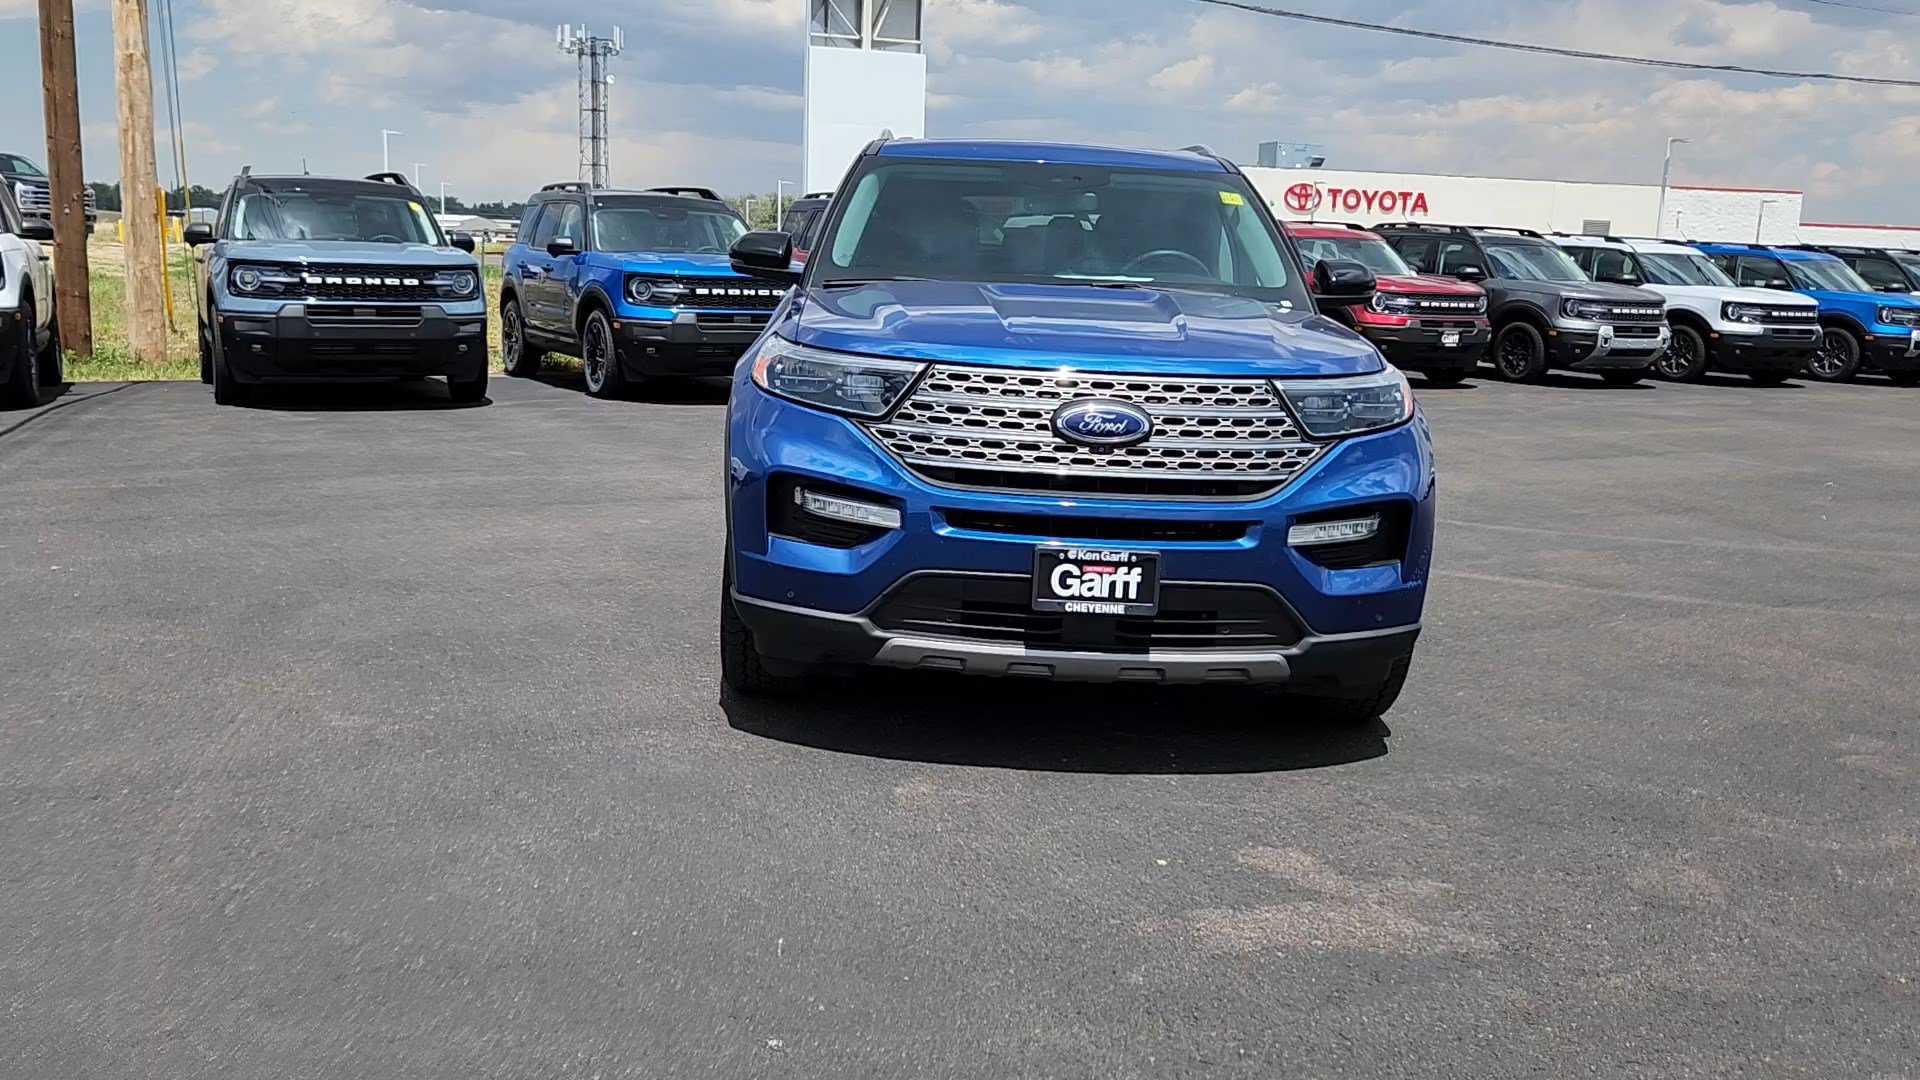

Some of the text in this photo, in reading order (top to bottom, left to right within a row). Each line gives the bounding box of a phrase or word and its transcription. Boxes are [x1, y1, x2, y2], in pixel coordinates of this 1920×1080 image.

[1328, 188, 1429, 215] TOYOTA
[305, 276, 420, 285] BRONCO
[695, 288, 786, 296] BRONCO
[1079, 412, 1128, 434] Ford
[1077, 549, 1129, 562] Ken Garff
[1050, 563, 1142, 599] Garff
[1065, 602, 1125, 614] CHEYENNE
